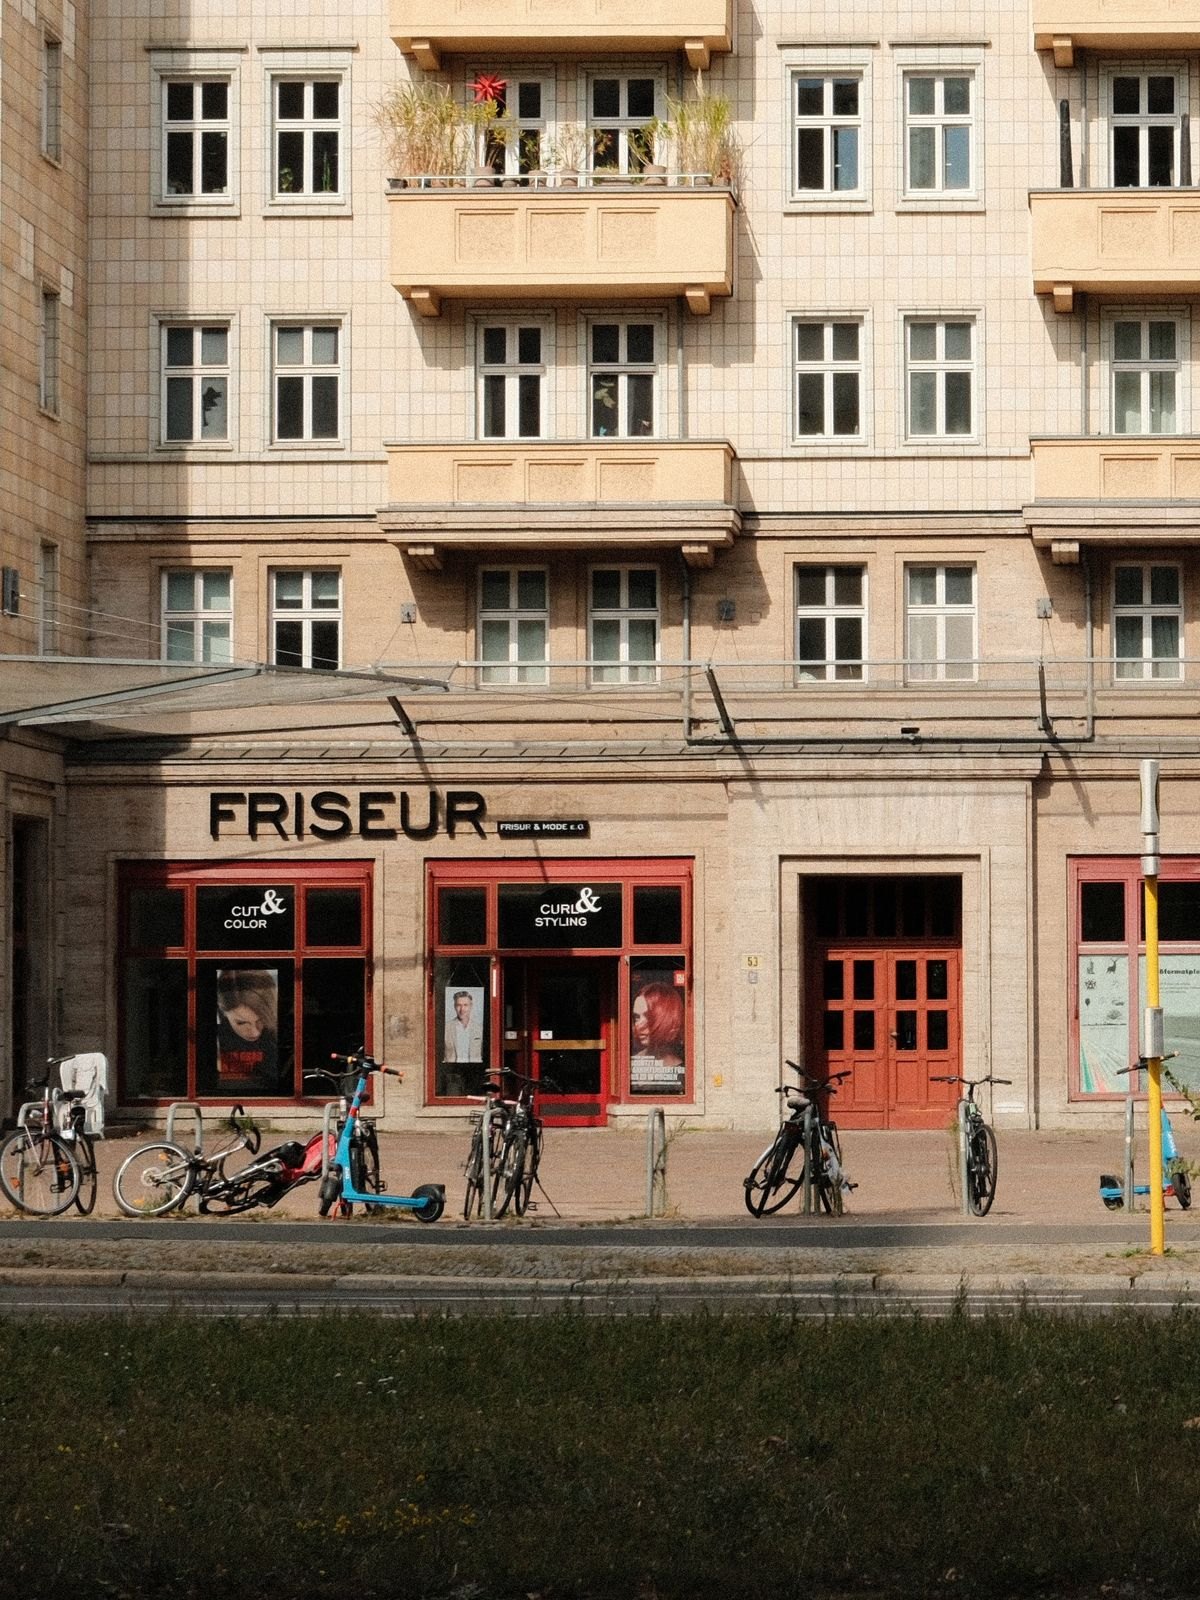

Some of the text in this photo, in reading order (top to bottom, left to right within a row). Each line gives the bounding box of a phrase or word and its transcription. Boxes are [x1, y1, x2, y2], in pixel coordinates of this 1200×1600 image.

[210, 790, 487, 841] FRISEUR
[500, 823, 532, 831] FRISUR
[533, 823, 541, 831] &
[542, 823, 568, 831] MODE
[231, 889, 287, 917] CUT &
[540, 887, 602, 915] CURL &
[223, 919, 268, 929] COLOR
[534, 917, 588, 927] STYLING
[747, 956, 758, 967] 53
